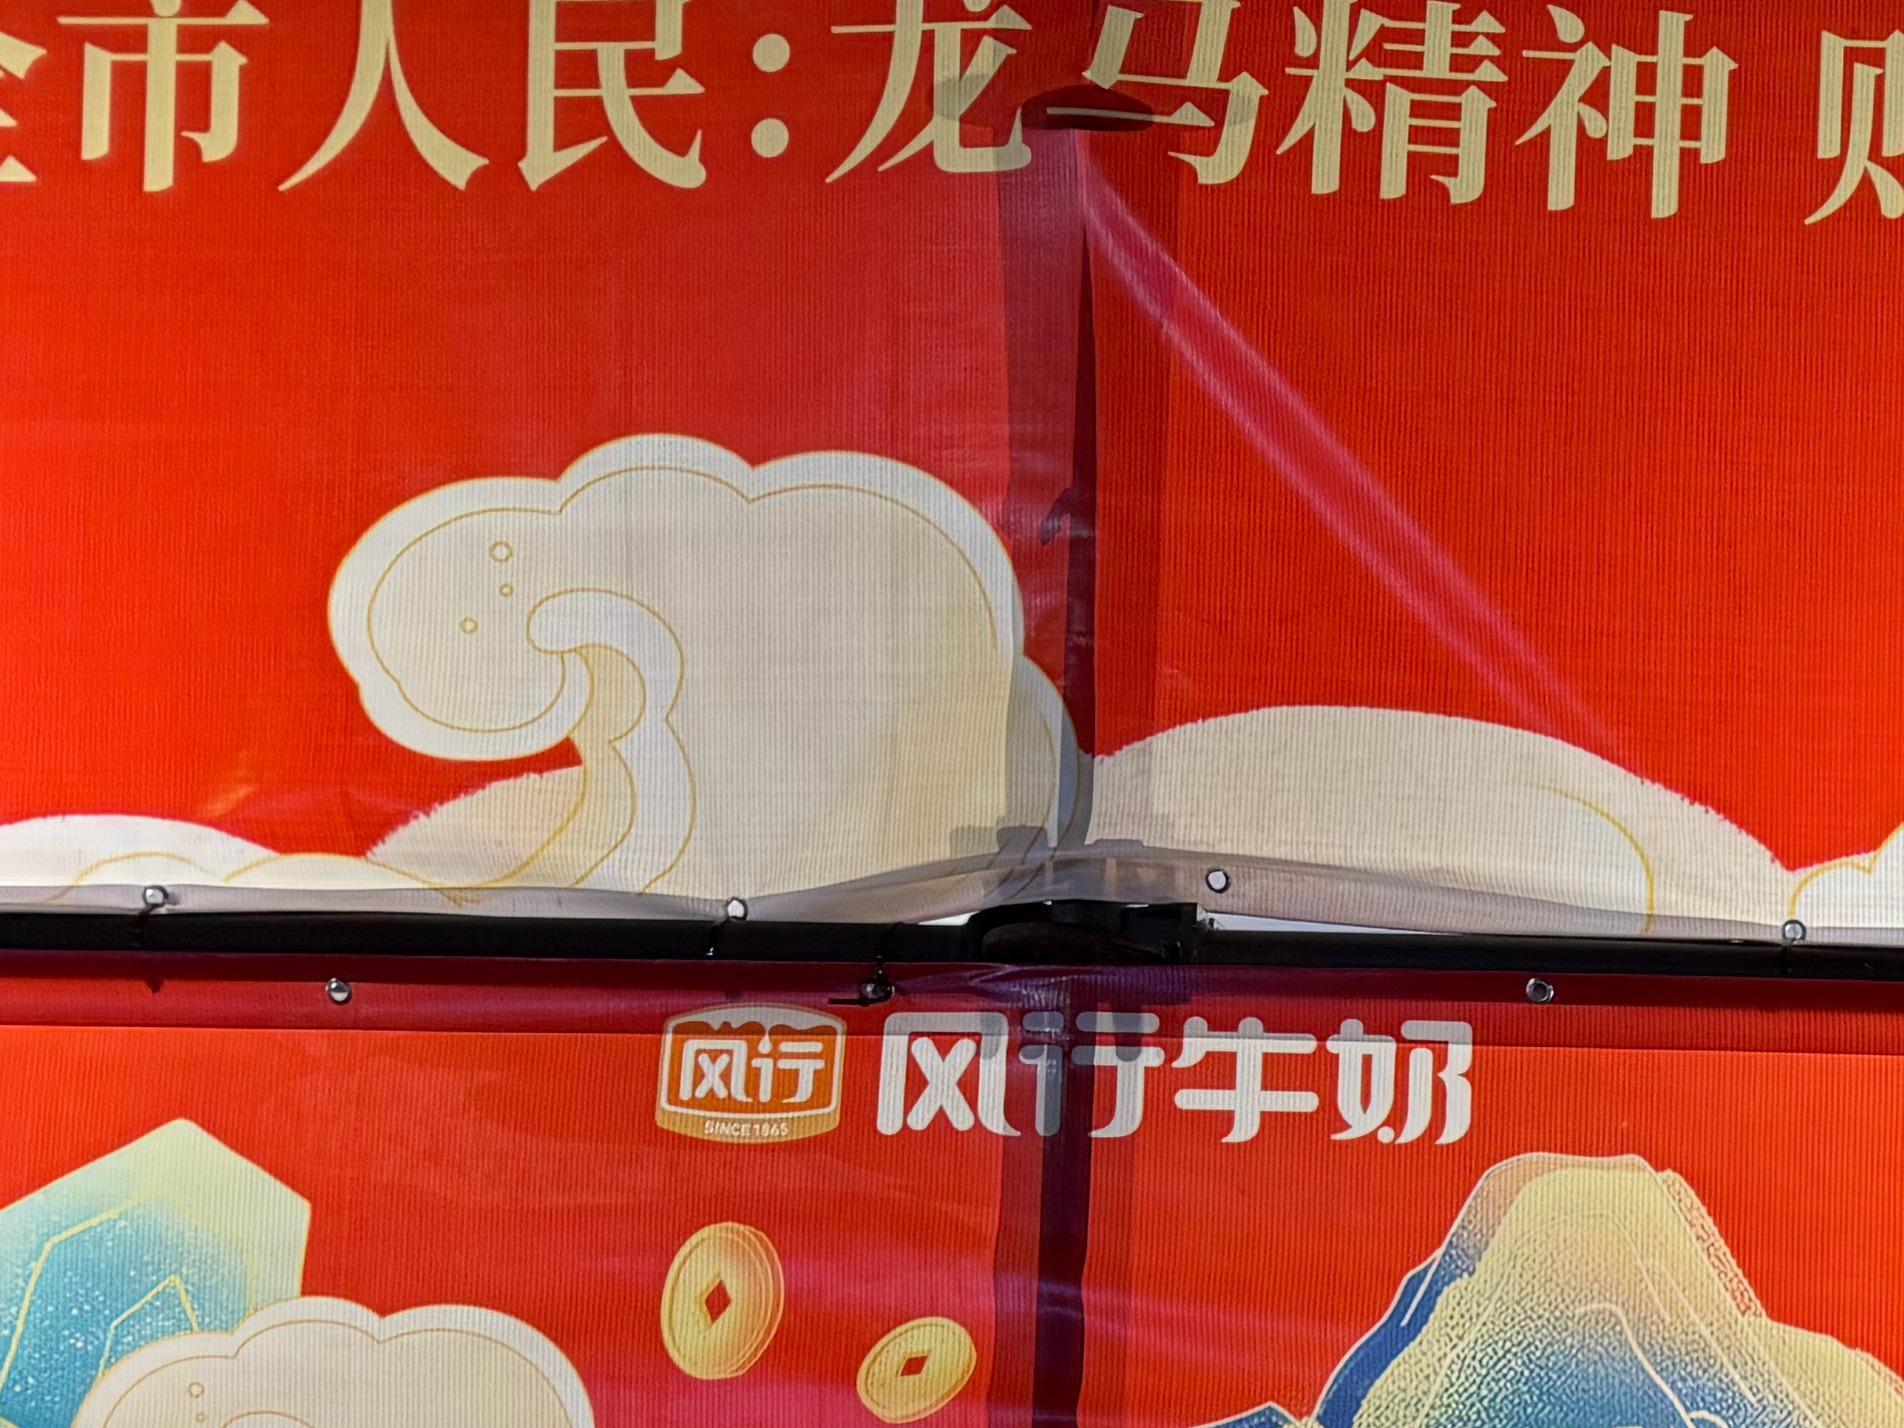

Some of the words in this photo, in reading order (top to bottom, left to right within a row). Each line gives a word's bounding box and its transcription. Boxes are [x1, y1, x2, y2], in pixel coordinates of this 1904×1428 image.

[679, 1039, 825, 1103] 风行
[877, 1010, 1473, 1146] 风行牛奶
[704, 1120, 751, 1136] SINCE
[752, 1122, 789, 1136] 1865
